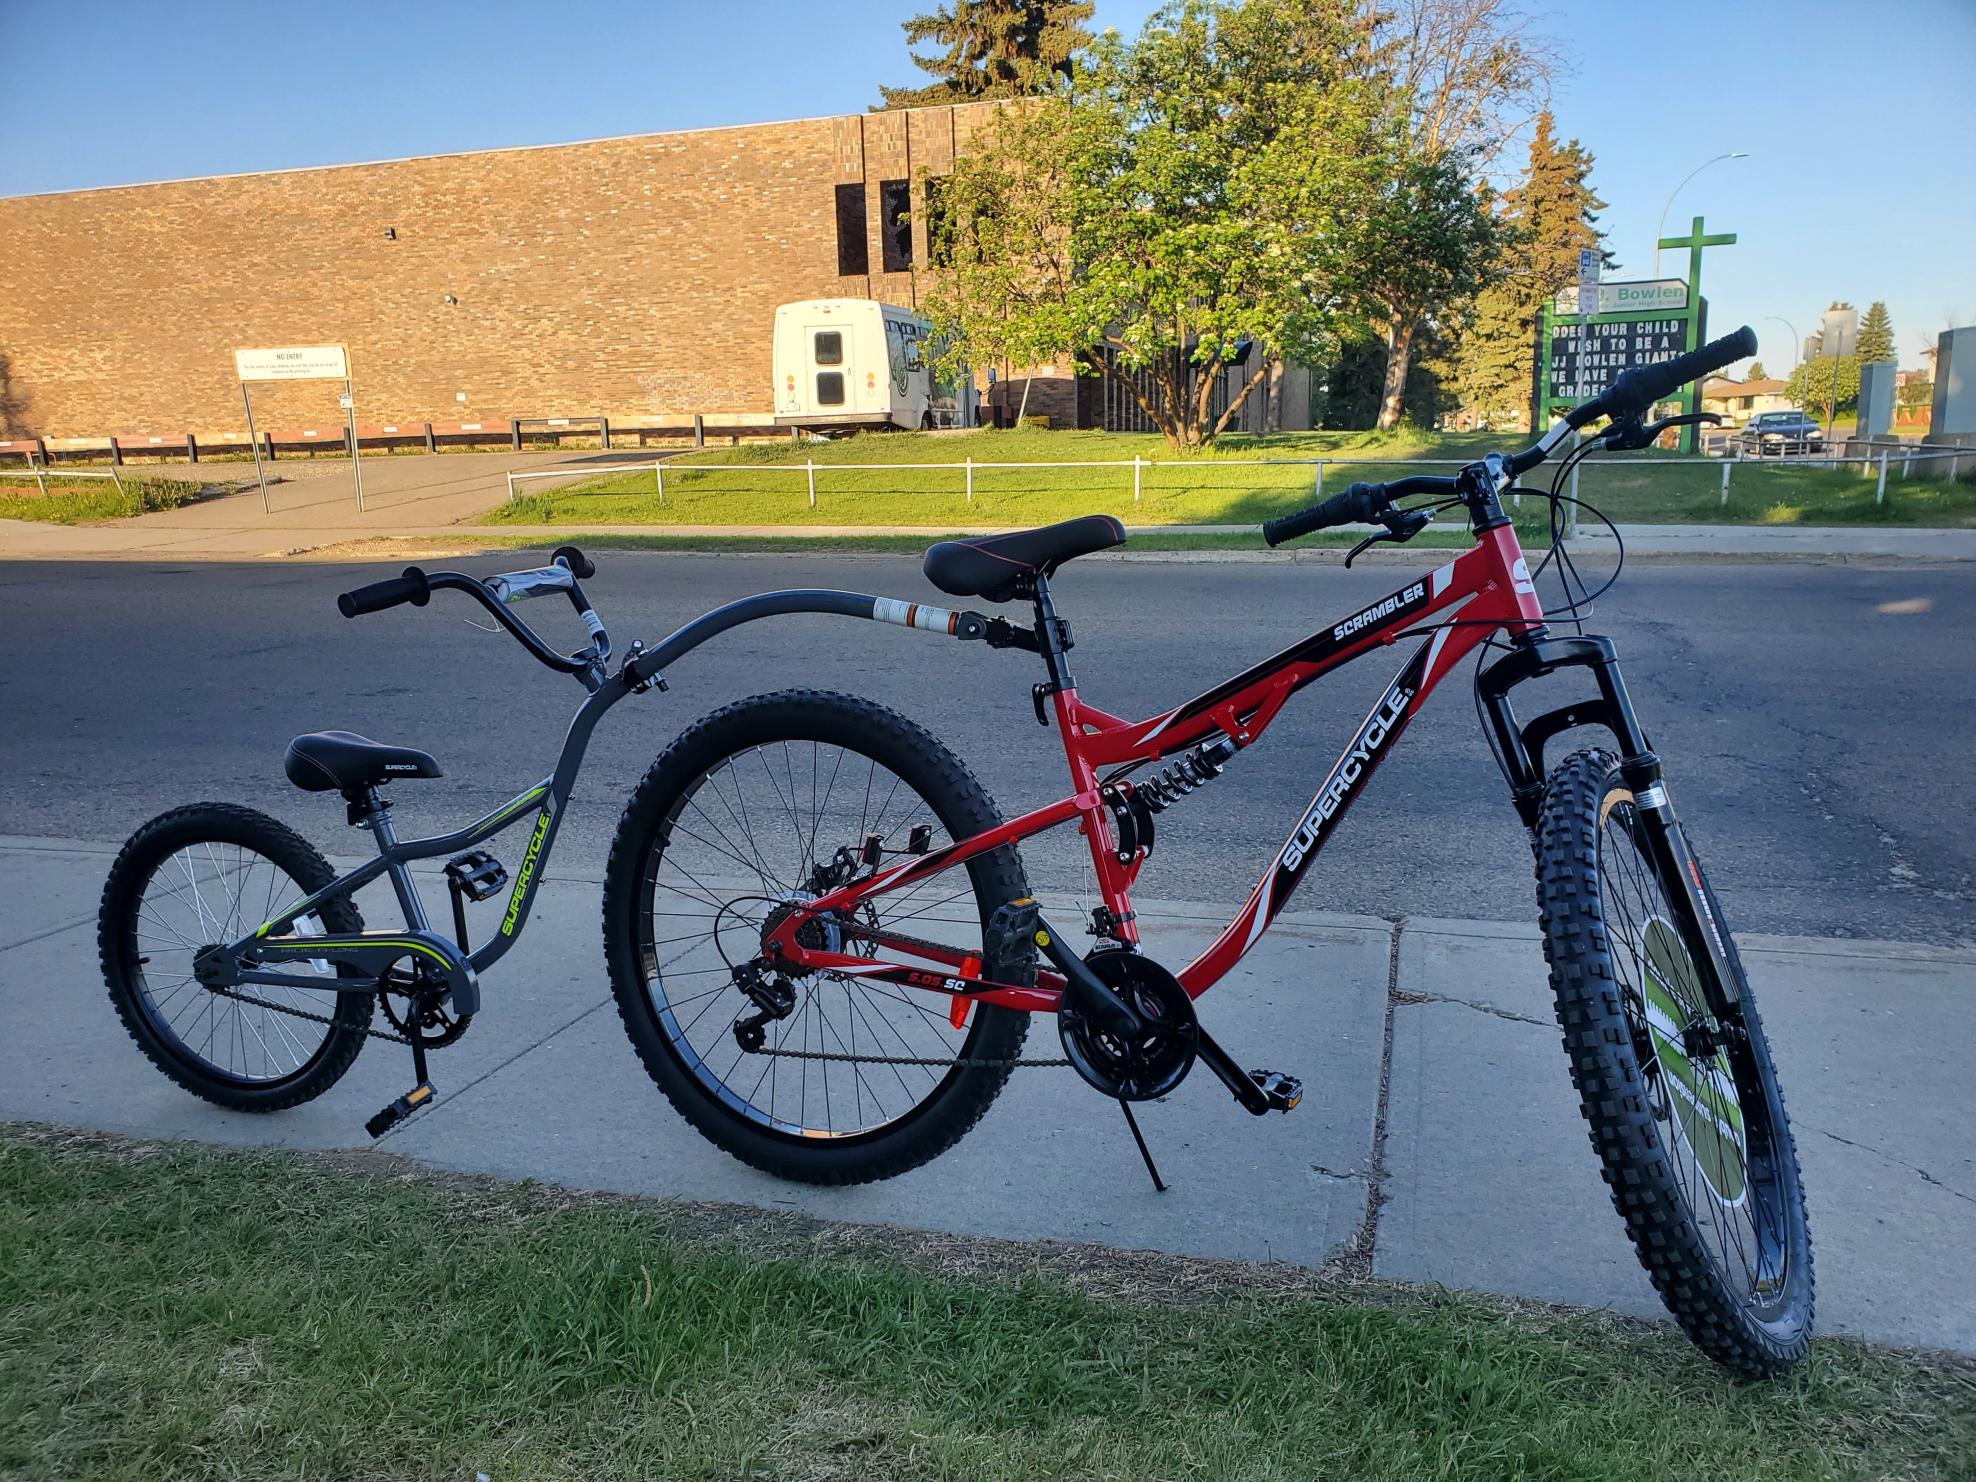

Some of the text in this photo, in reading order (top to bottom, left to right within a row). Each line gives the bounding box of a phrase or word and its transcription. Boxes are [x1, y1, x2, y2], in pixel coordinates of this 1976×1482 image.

[1618, 286, 1684, 301] Bowlen
[1594, 323, 1627, 336] YOUR
[1637, 320, 1679, 334] CHILD
[1568, 336, 1669, 353] WISH TO BE A
[1552, 356, 1567, 368] JJ
[1551, 371, 1567, 383] WE
[1333, 582, 1425, 642] SCRAMBLER
[1282, 686, 1409, 872] SUPERCYCLE
[501, 812, 549, 937] SUPERCYCLE
